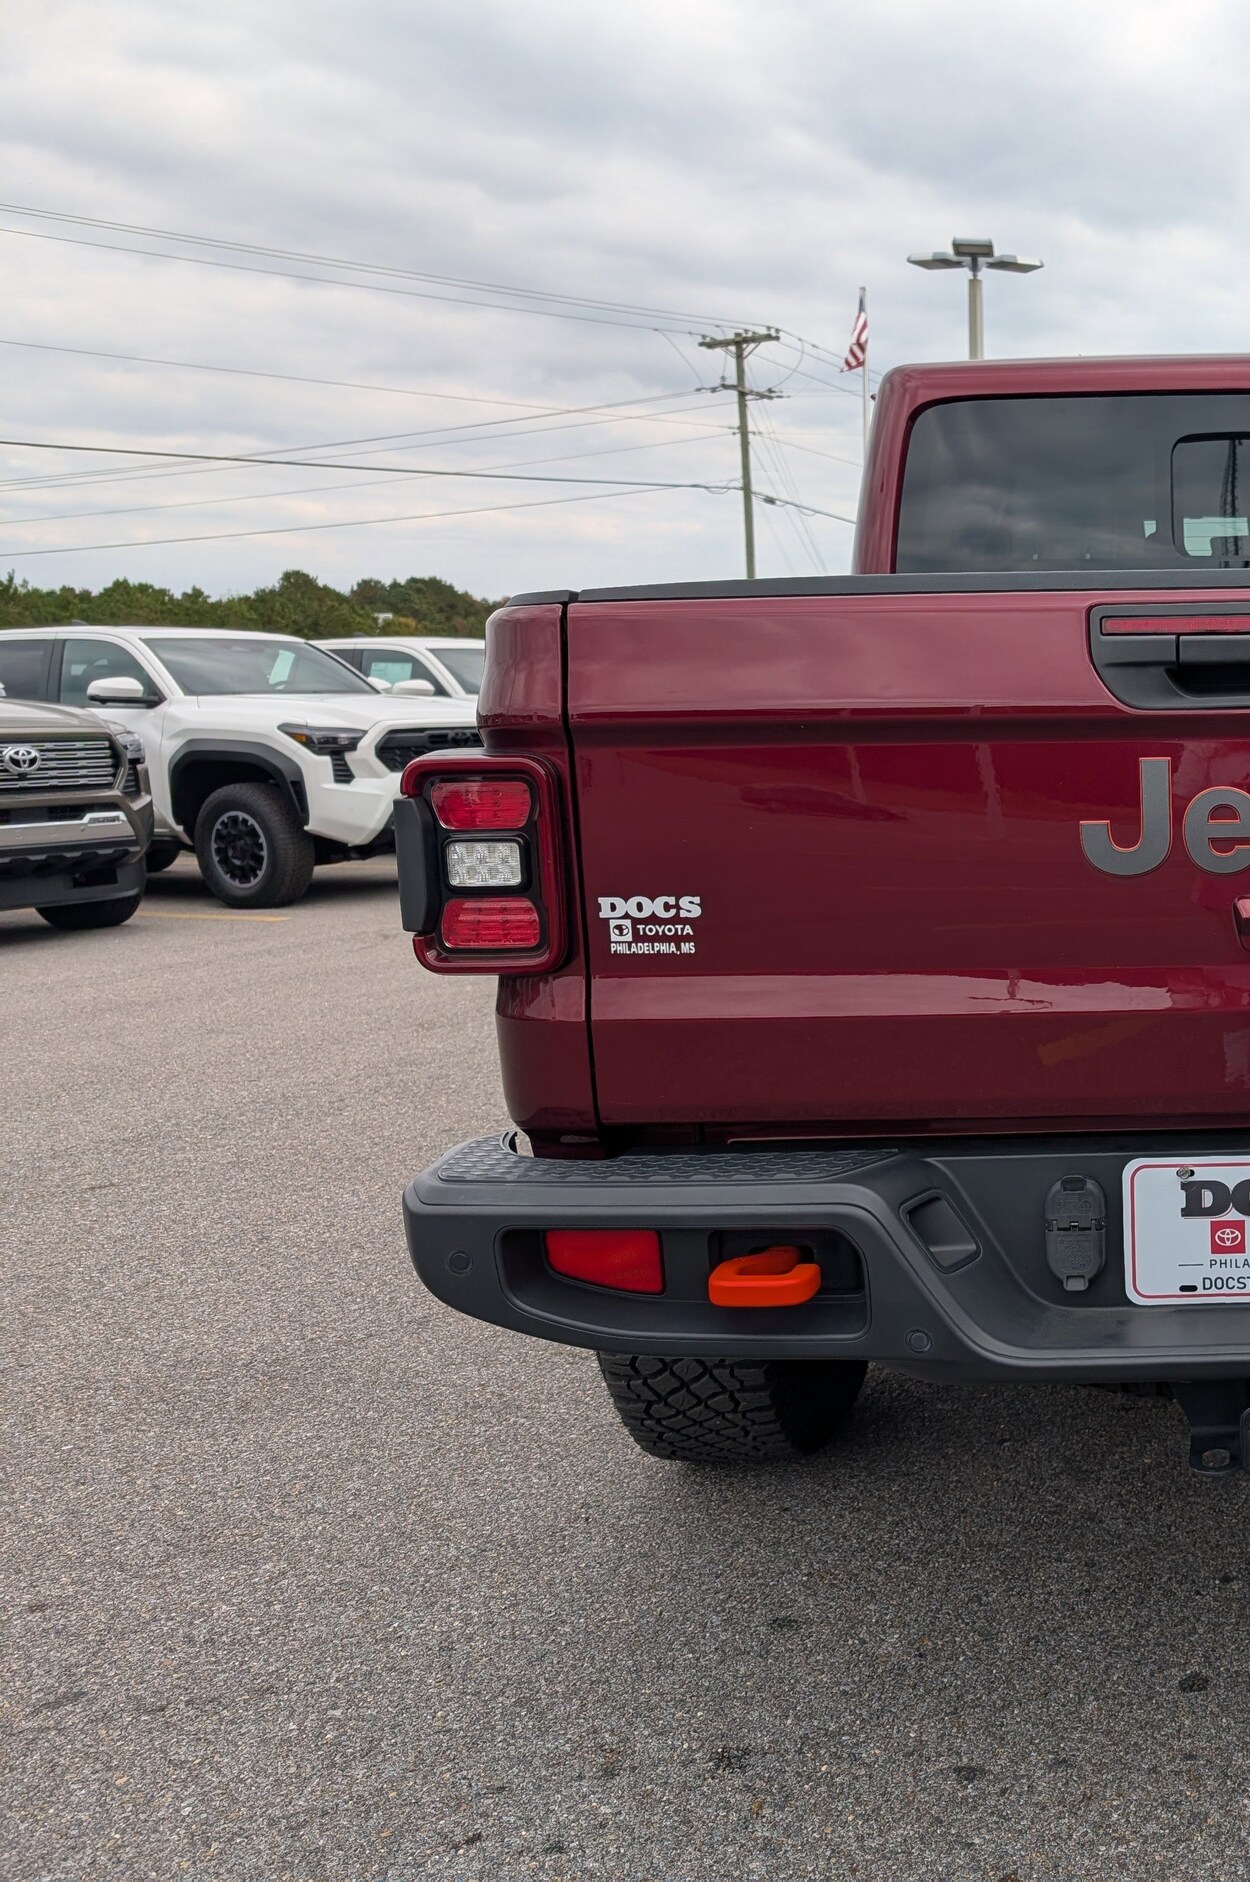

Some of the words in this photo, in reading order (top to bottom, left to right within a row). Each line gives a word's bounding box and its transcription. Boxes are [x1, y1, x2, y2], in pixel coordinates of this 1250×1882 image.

[636, 925, 694, 936] TOYOTA
[610, 942, 680, 955] PHILADELPHIA,
[681, 942, 696, 954] MS
